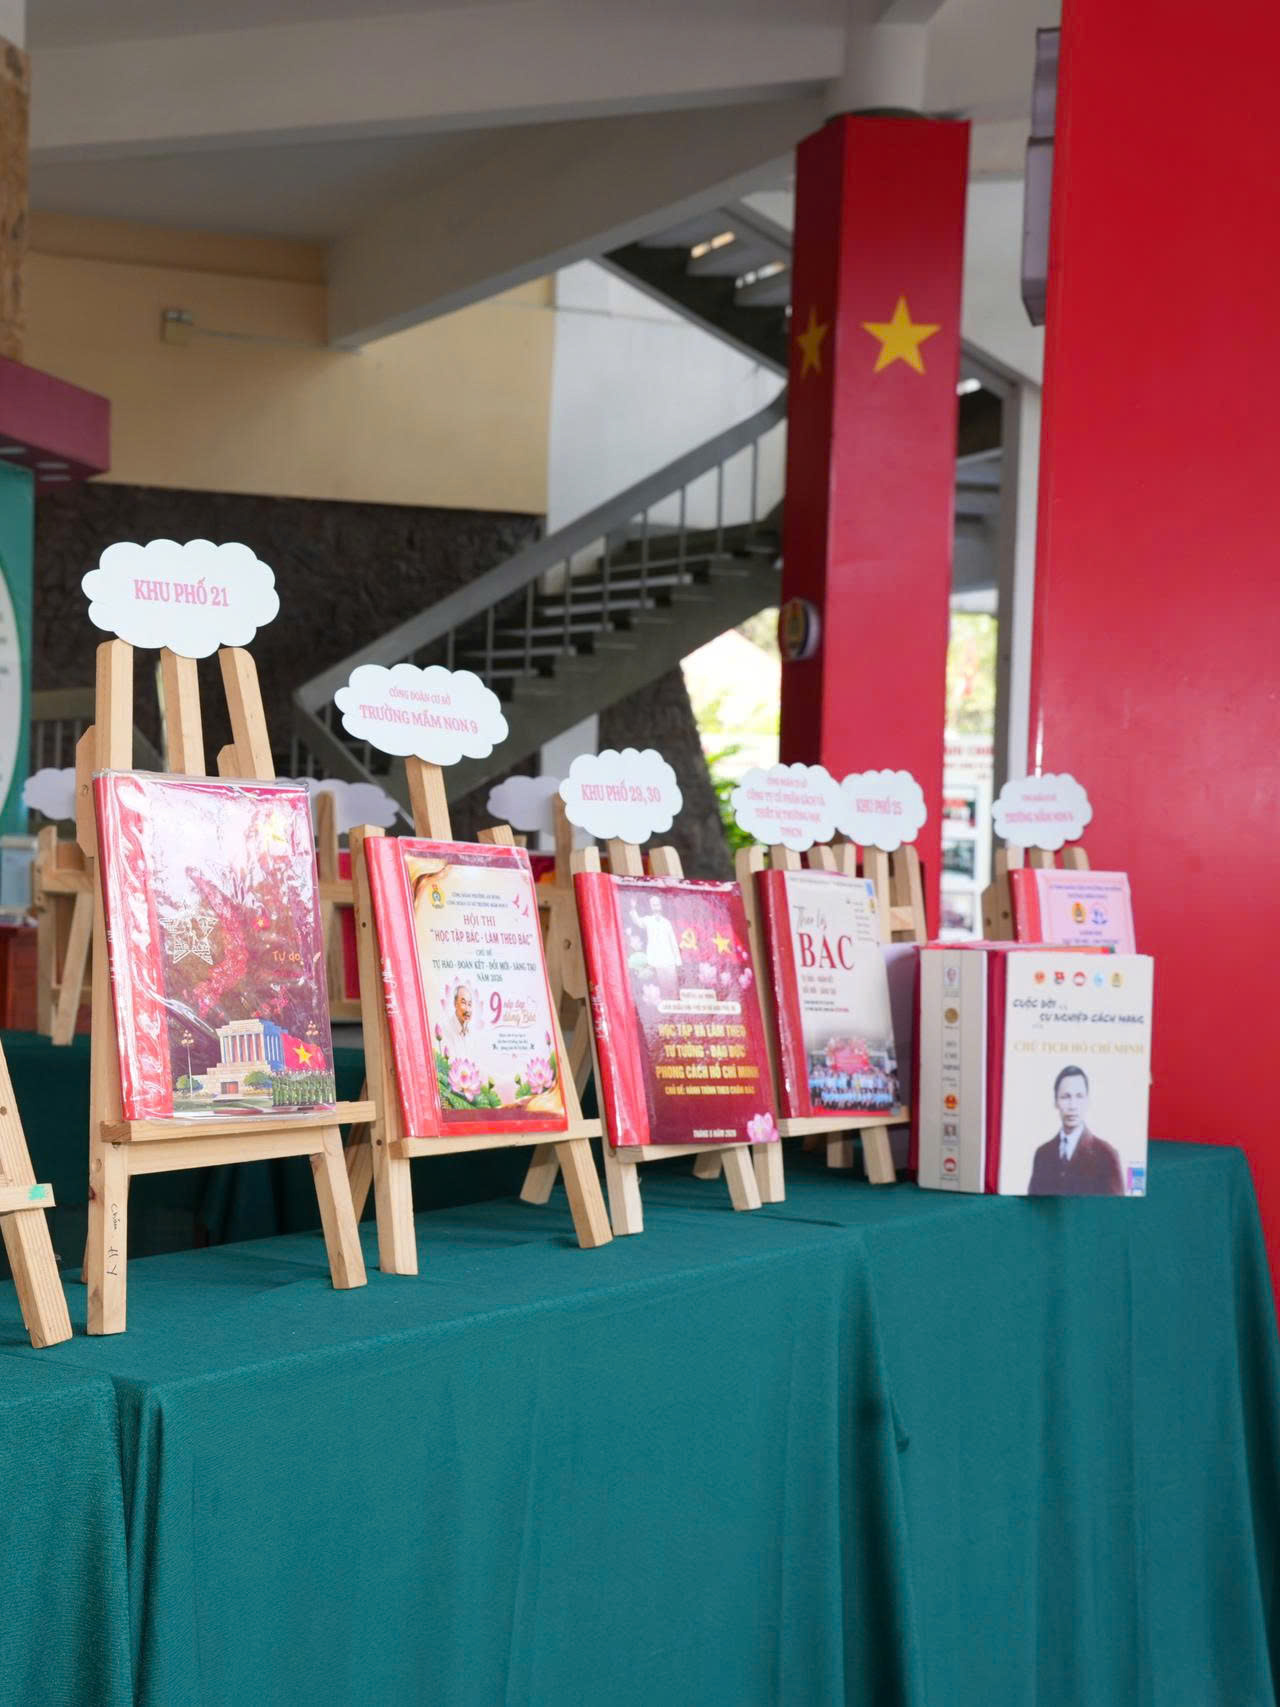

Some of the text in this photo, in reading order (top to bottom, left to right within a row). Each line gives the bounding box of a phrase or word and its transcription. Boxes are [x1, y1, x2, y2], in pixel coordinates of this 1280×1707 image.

[133, 576, 231, 607] KHU PHỐ 21
[359, 702, 410, 725] TRƯỜNG
[411, 709, 442, 730] MẦM
[444, 717, 469, 733] NON
[581, 783, 604, 801] KHU
[605, 779, 628, 802] PHỐ
[463, 911, 496, 929] HỘI THI
[489, 991, 502, 1025] 9
